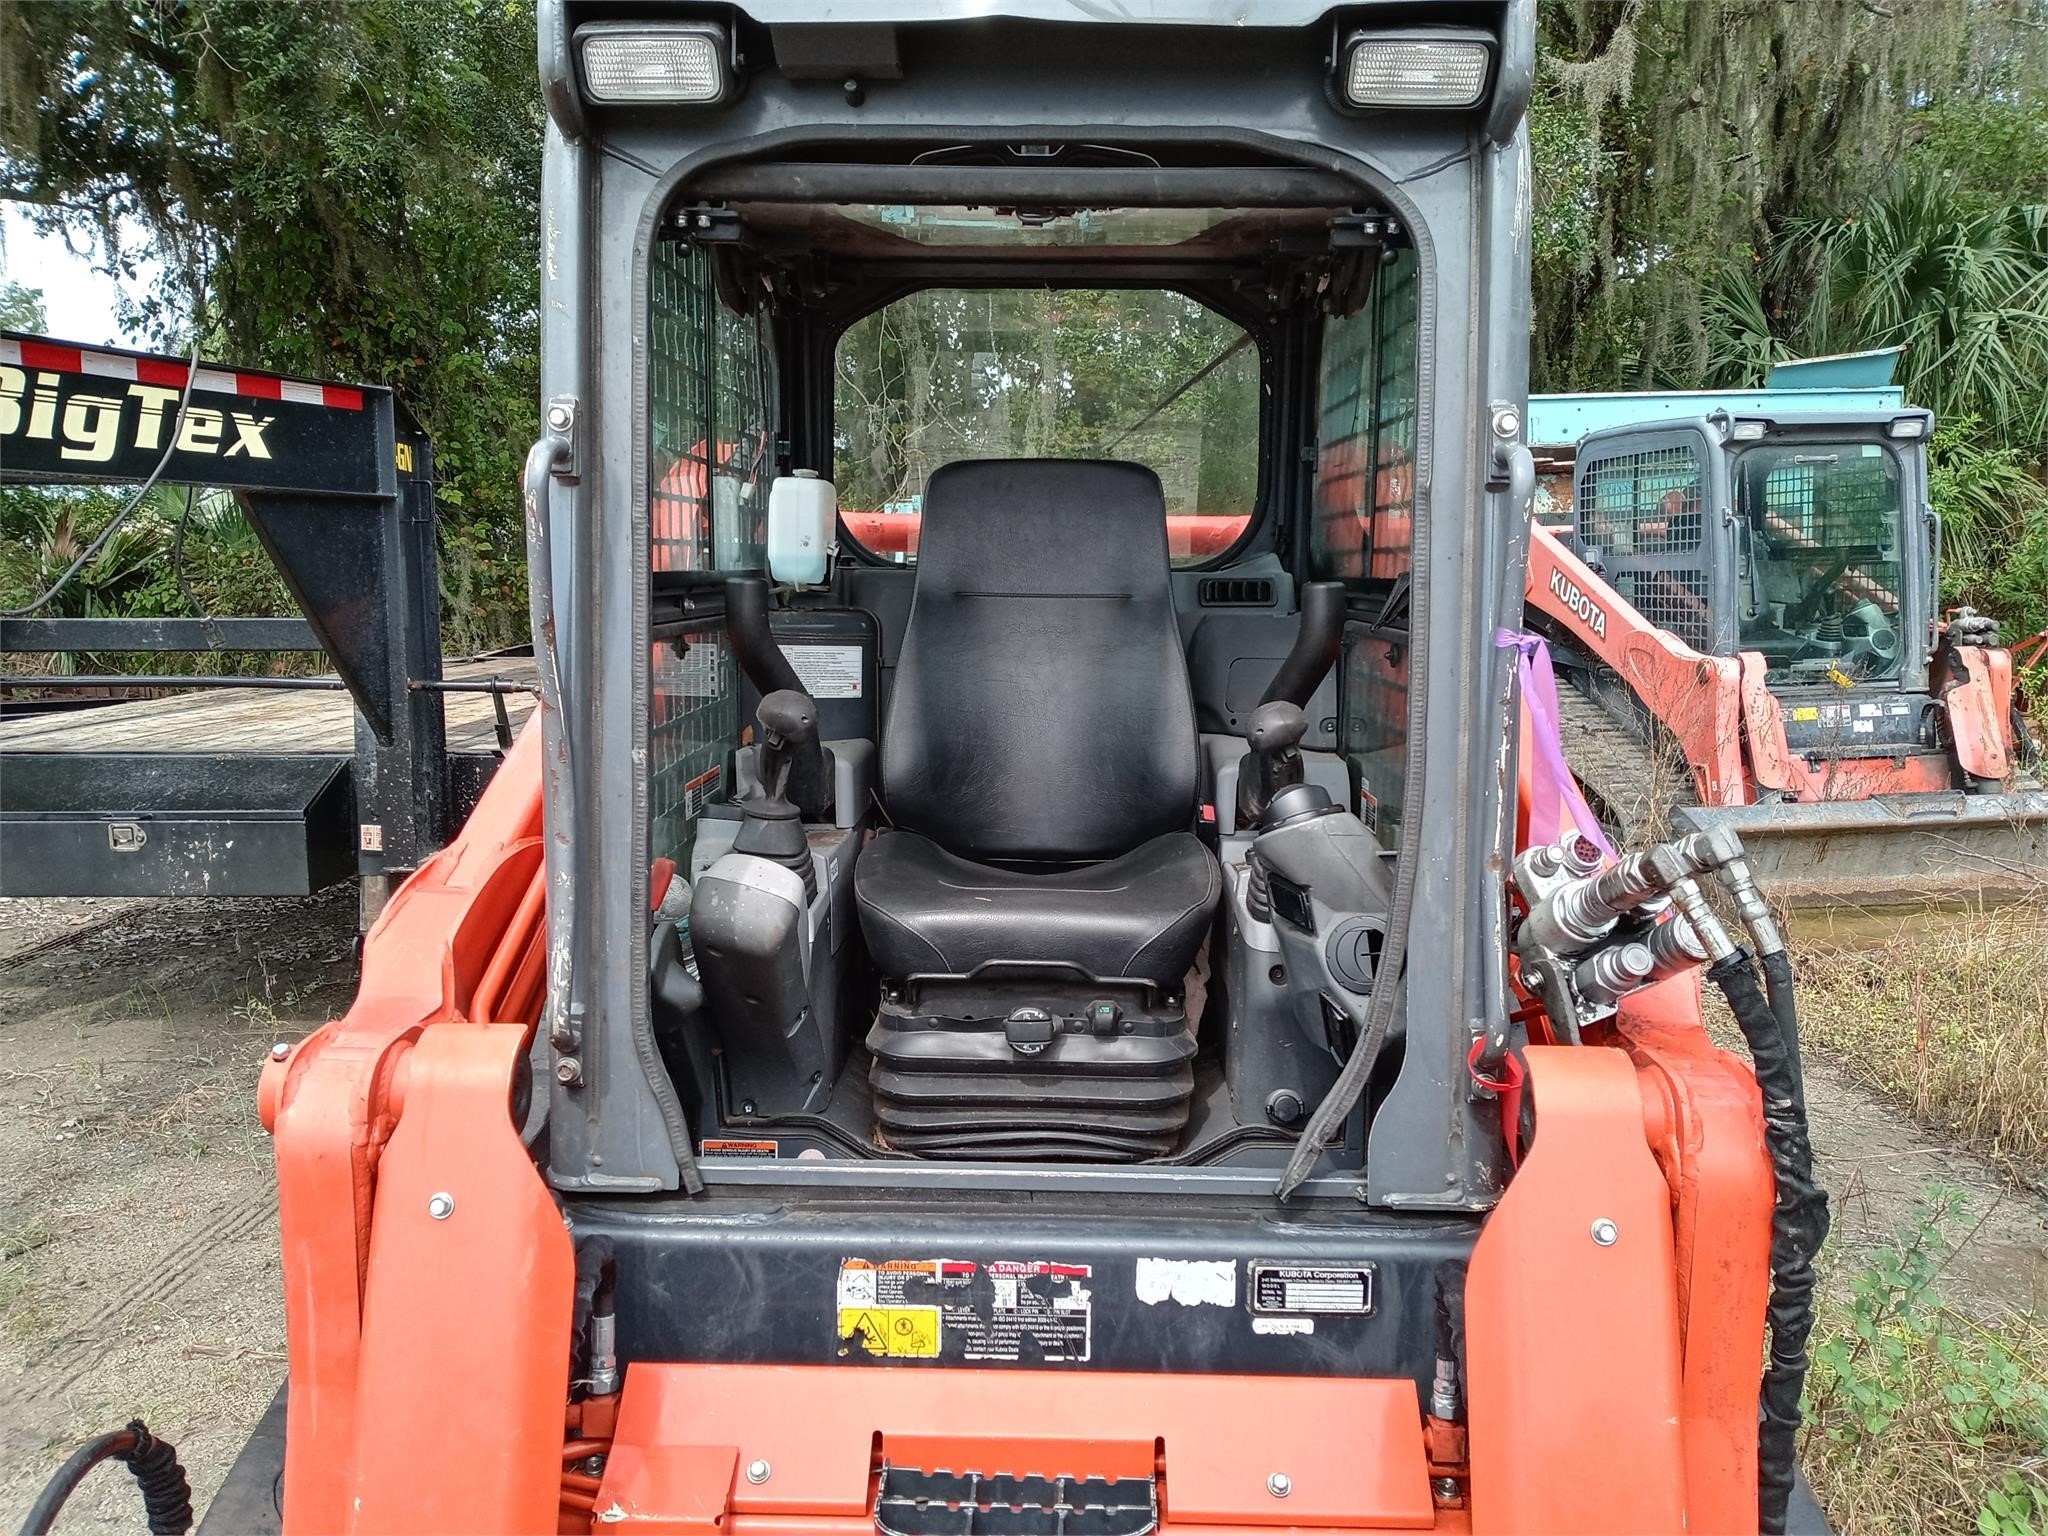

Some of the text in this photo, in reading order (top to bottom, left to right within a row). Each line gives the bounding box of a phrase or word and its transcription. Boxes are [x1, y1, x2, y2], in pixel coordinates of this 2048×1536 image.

[396, 442, 412, 472] GN
[1549, 566, 1606, 640] KUBOTA
[999, 1264, 1040, 1273] DANGER
[1279, 1270, 1359, 1280] KUBOTA Corporation
